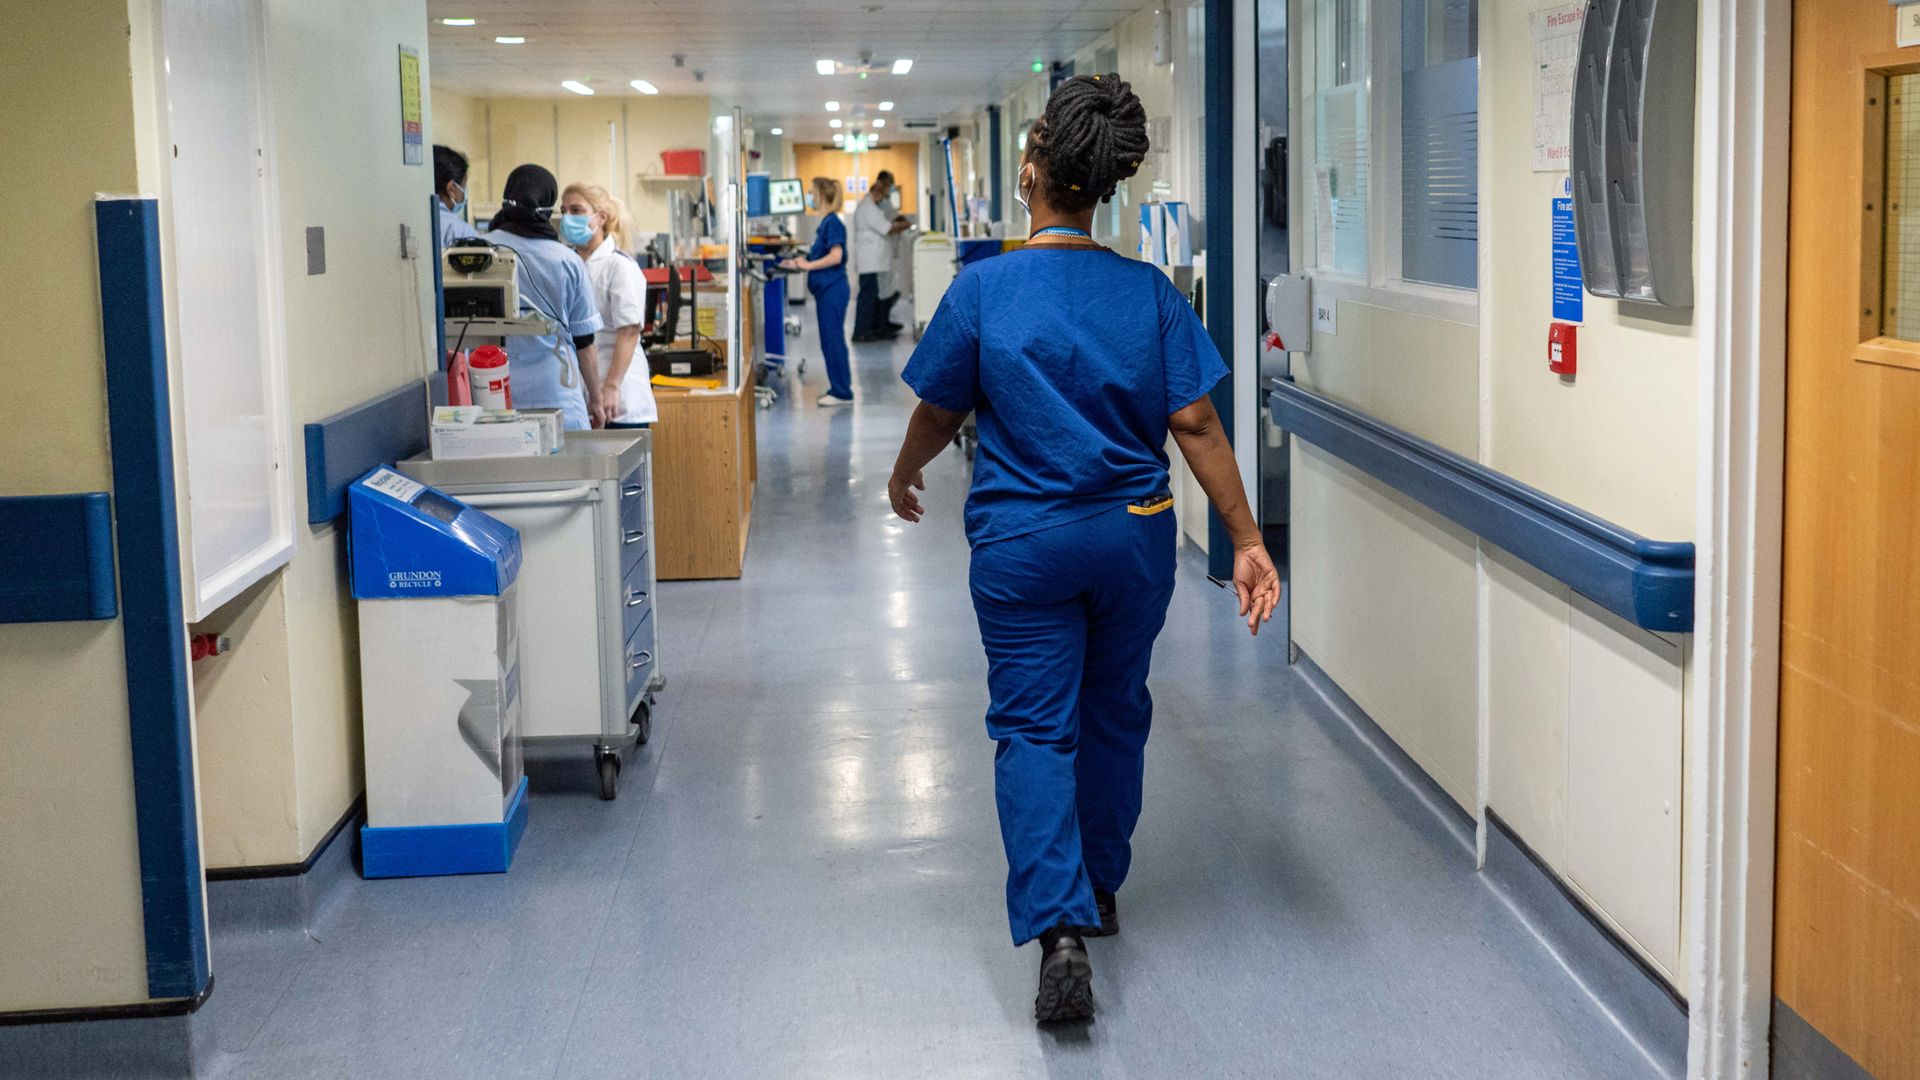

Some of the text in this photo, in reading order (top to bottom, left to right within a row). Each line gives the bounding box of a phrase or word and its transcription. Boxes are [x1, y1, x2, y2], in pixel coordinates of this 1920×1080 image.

[1547, 15, 1557, 28] Fire
[1558, 12, 1576, 25] Escape
[1547, 145, 1559, 159] Ward
[1557, 200, 1566, 211] Fire
[1318, 307, 1326, 320] BAY
[389, 570, 441, 580] GRUNDON
